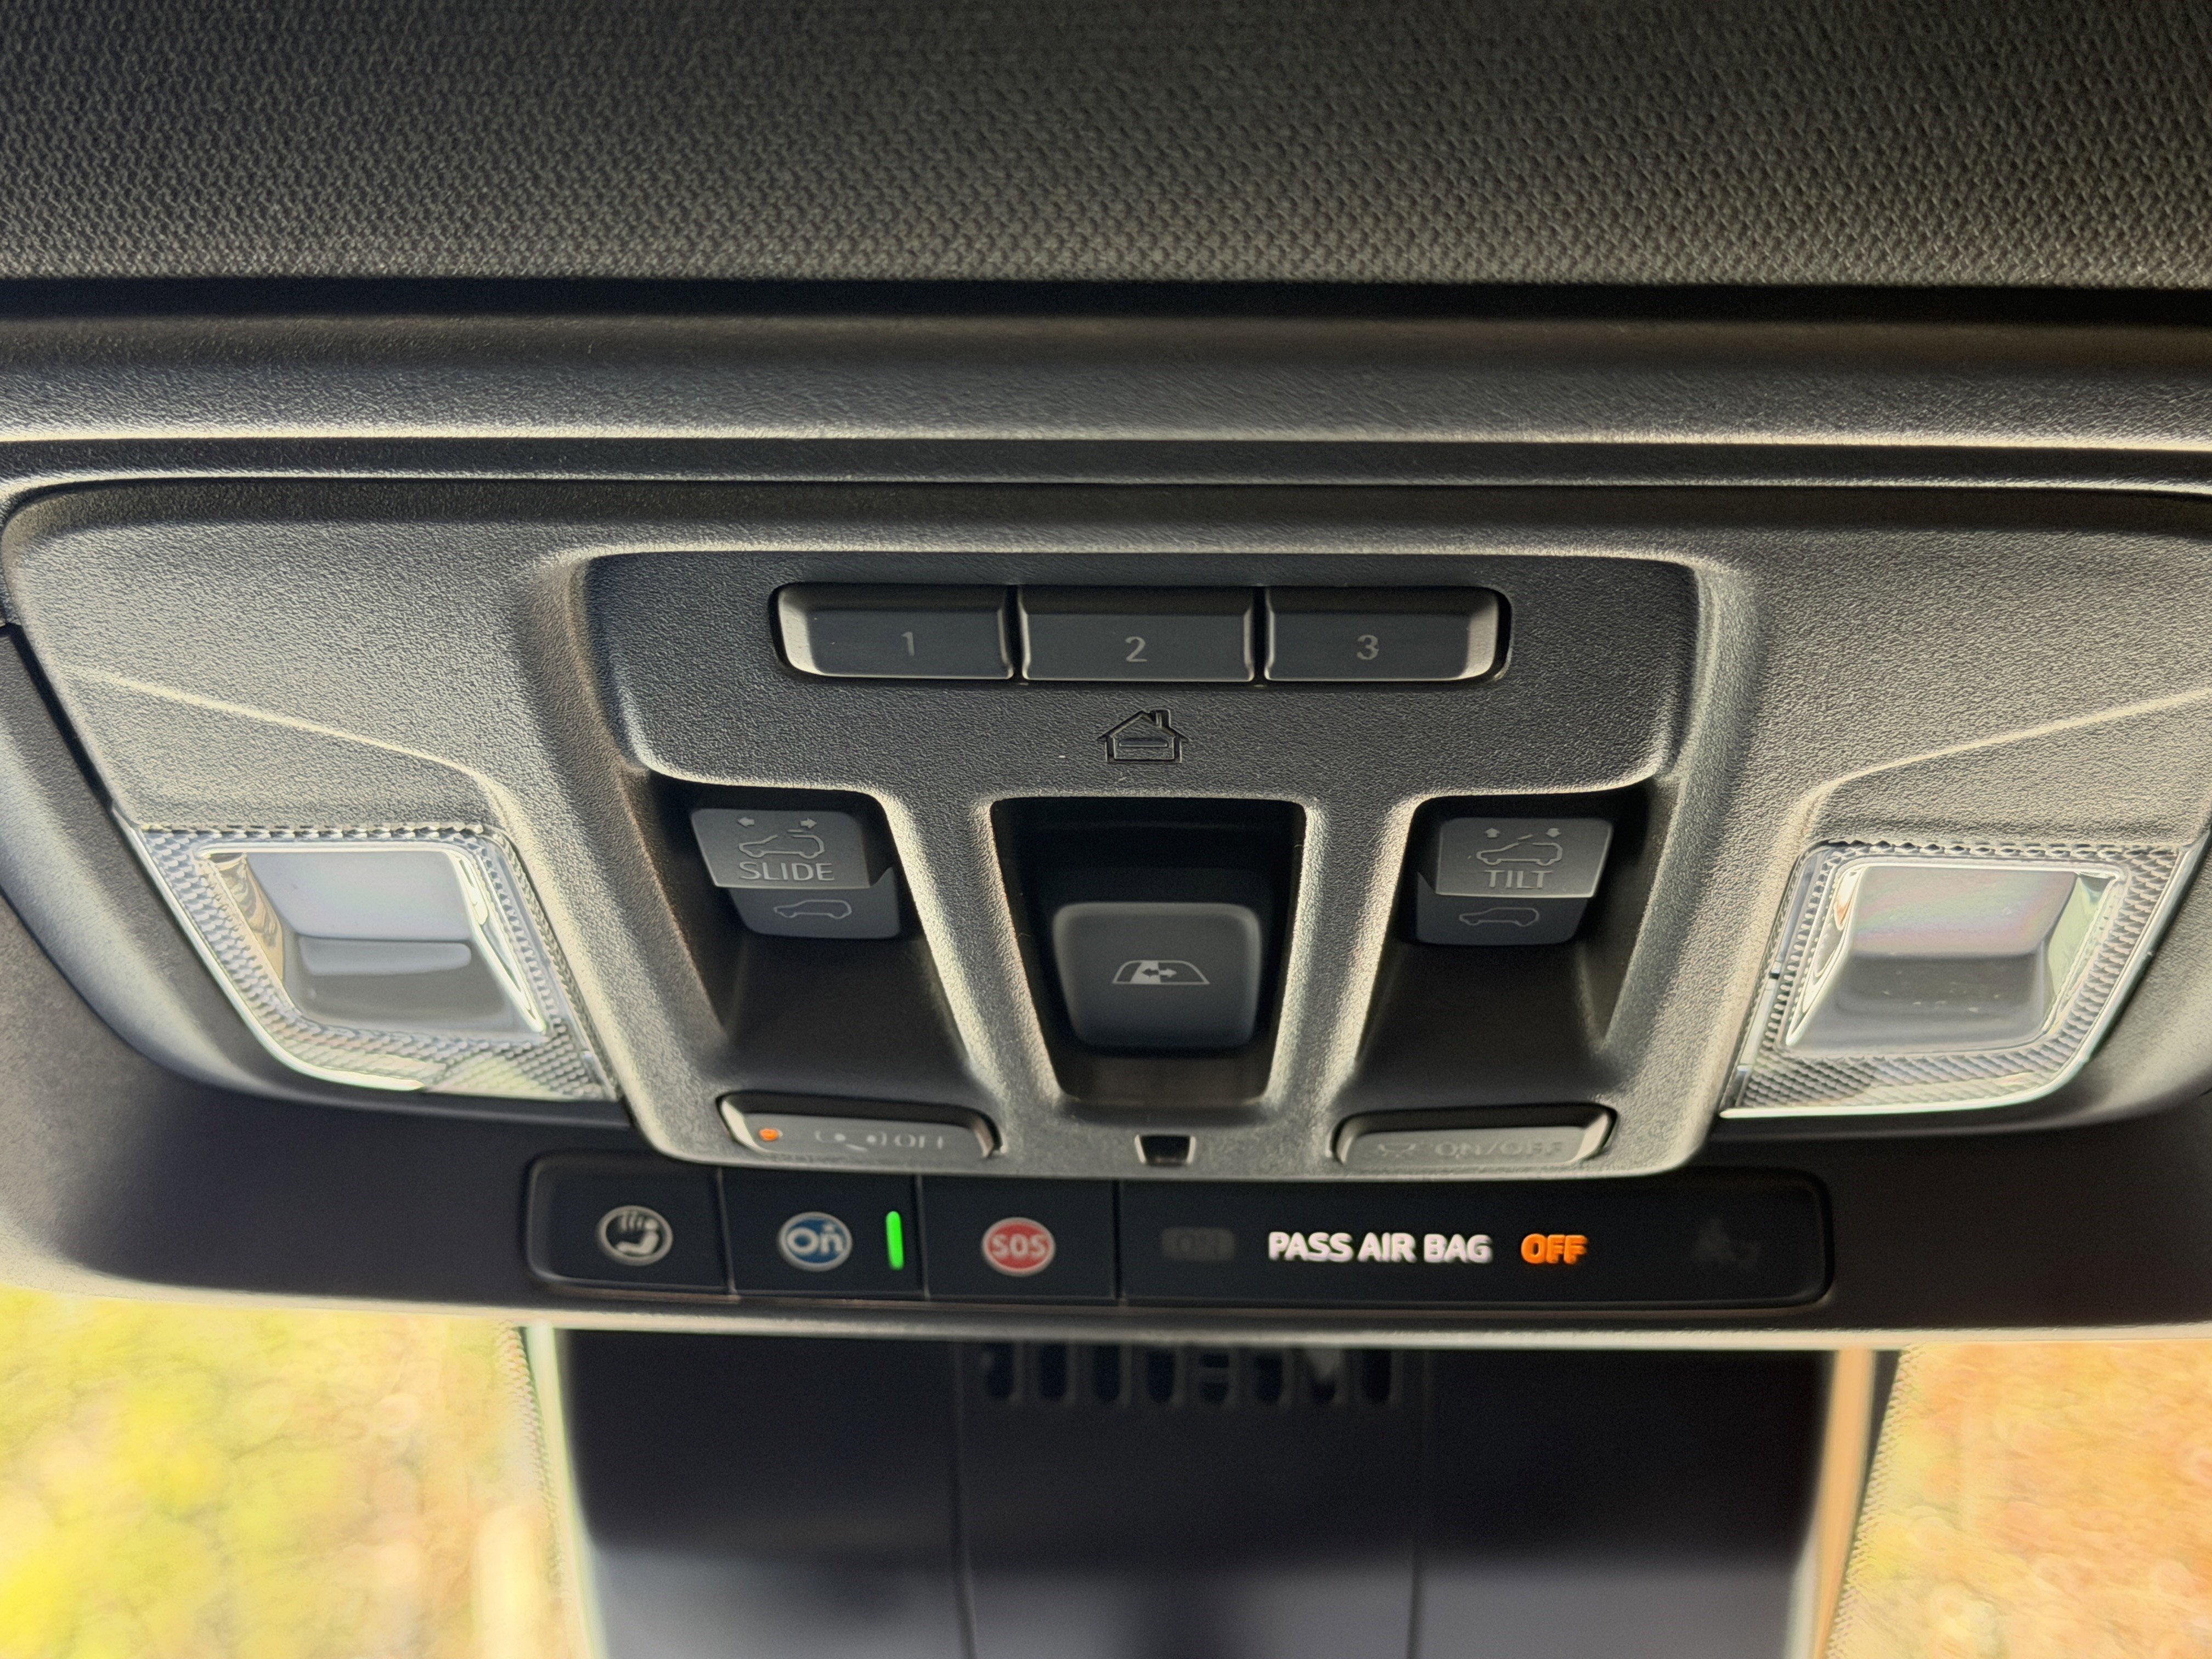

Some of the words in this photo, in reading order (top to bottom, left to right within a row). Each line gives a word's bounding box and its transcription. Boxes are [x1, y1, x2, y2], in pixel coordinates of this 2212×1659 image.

[901, 631, 915, 657] 1
[1125, 636, 1148, 662] 2
[1357, 635, 1379, 660] 3
[738, 861, 835, 882] SLIDE
[1483, 870, 1554, 889] TILT
[992, 1233, 1047, 1259] SOS
[1268, 1231, 1353, 1262] PASS
[1357, 1232, 1417, 1262] AIR
[1424, 1233, 1493, 1263] BAG
[1520, 1233, 1588, 1264] OFF
